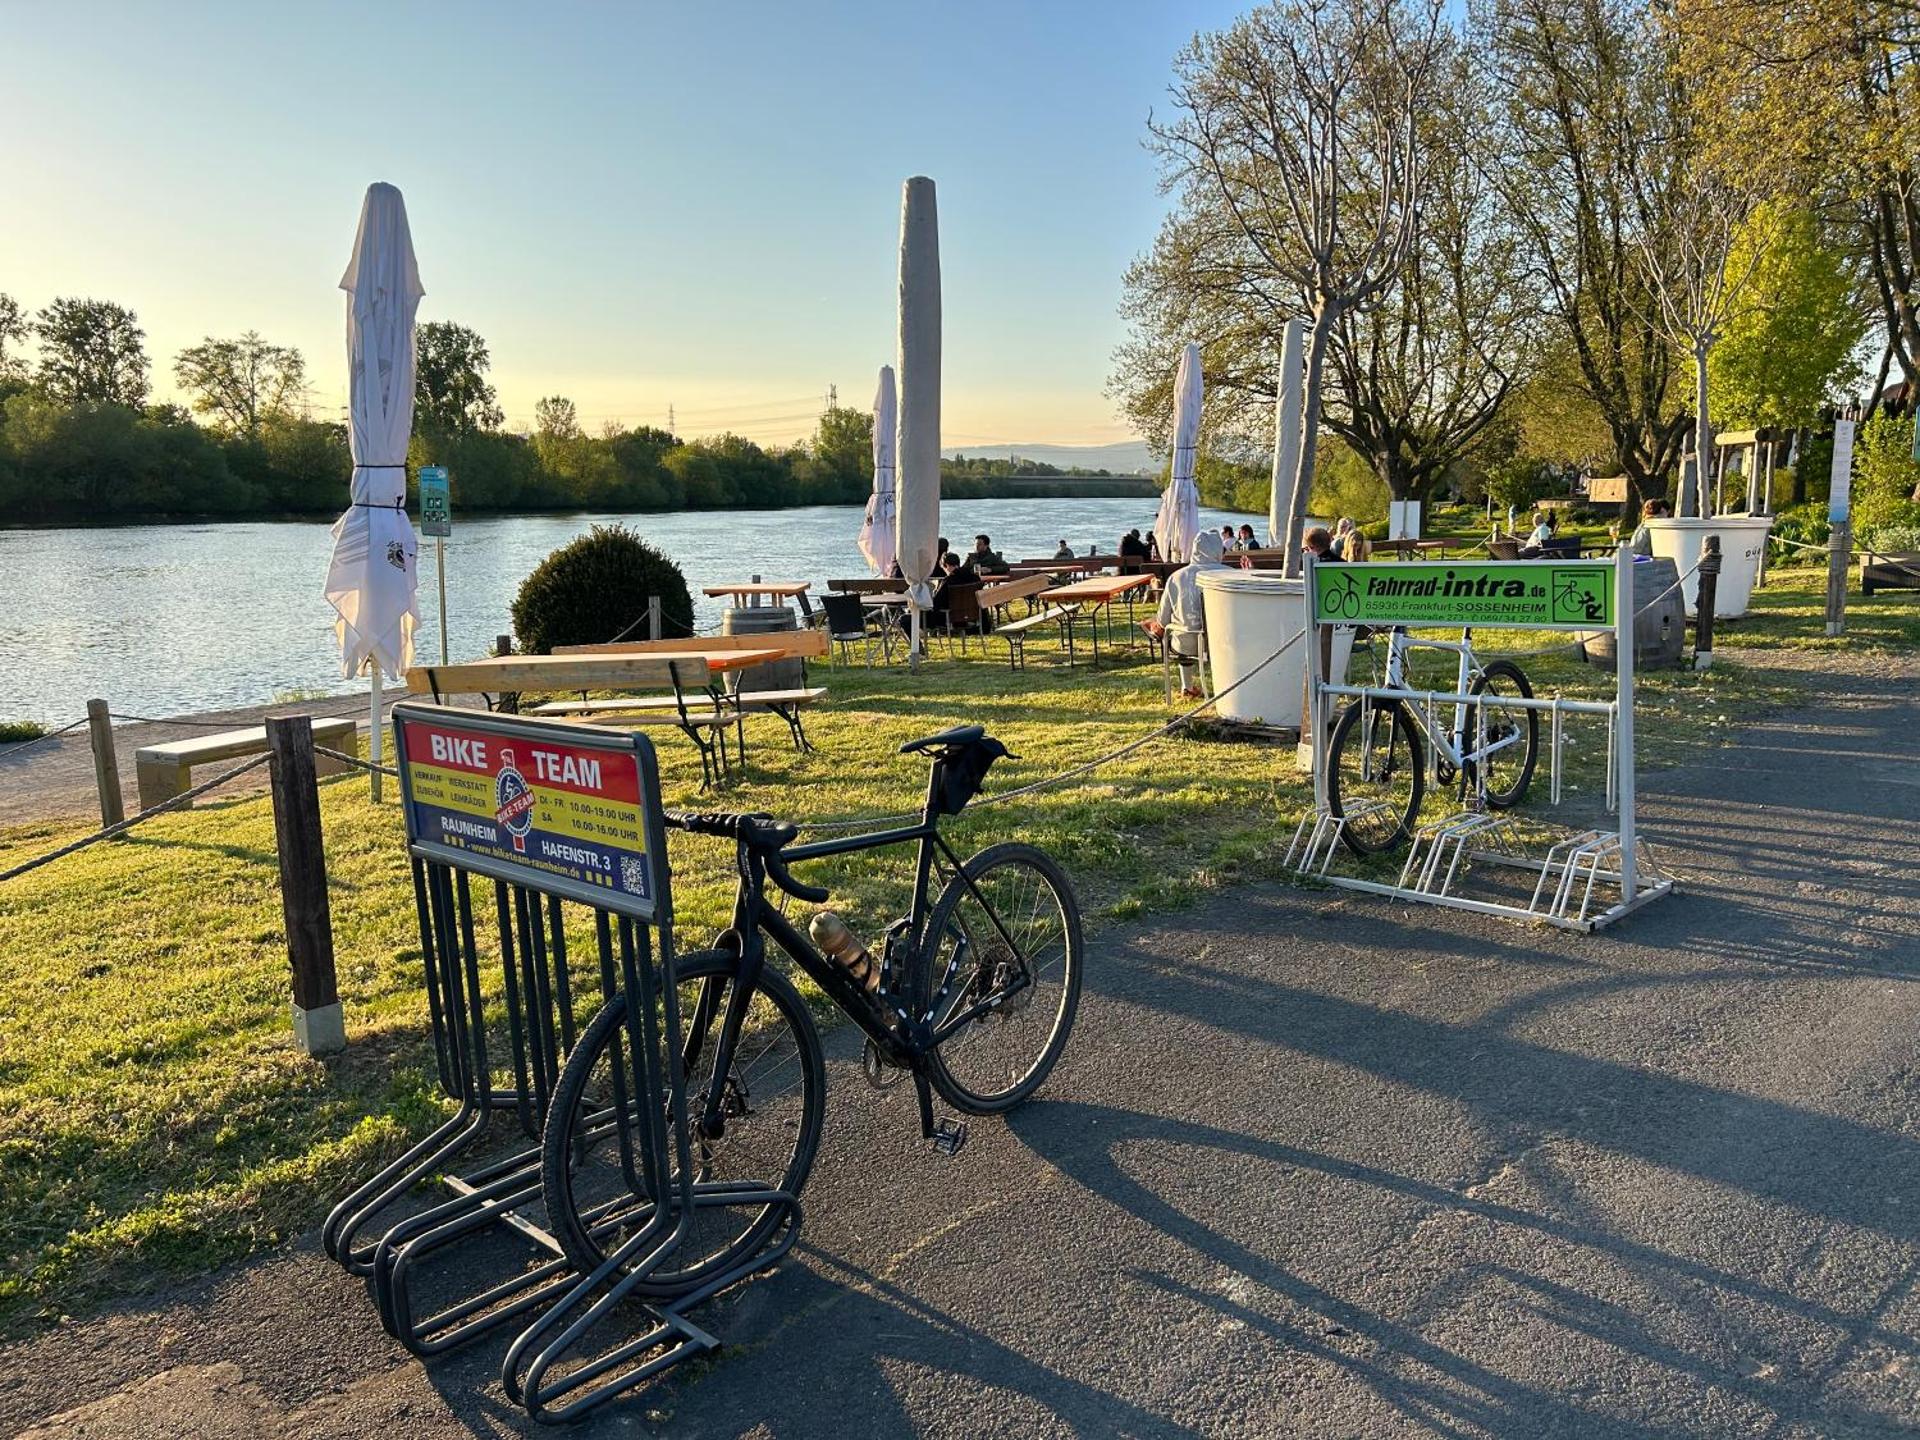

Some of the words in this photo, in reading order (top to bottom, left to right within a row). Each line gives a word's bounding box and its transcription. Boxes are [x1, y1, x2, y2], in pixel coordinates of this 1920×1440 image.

[430, 734, 489, 769] BIKE
[531, 750, 603, 790] TEAM
[541, 812, 553, 823] SA
[620, 829, 640, 842] UHR
[570, 801, 617, 820] 10.00-19.00
[617, 811, 637, 824] UHR
[440, 816, 498, 842] RAUNHEIM
[541, 840, 602, 869] HAFENSTR.
[603, 856, 612, 871] 3
